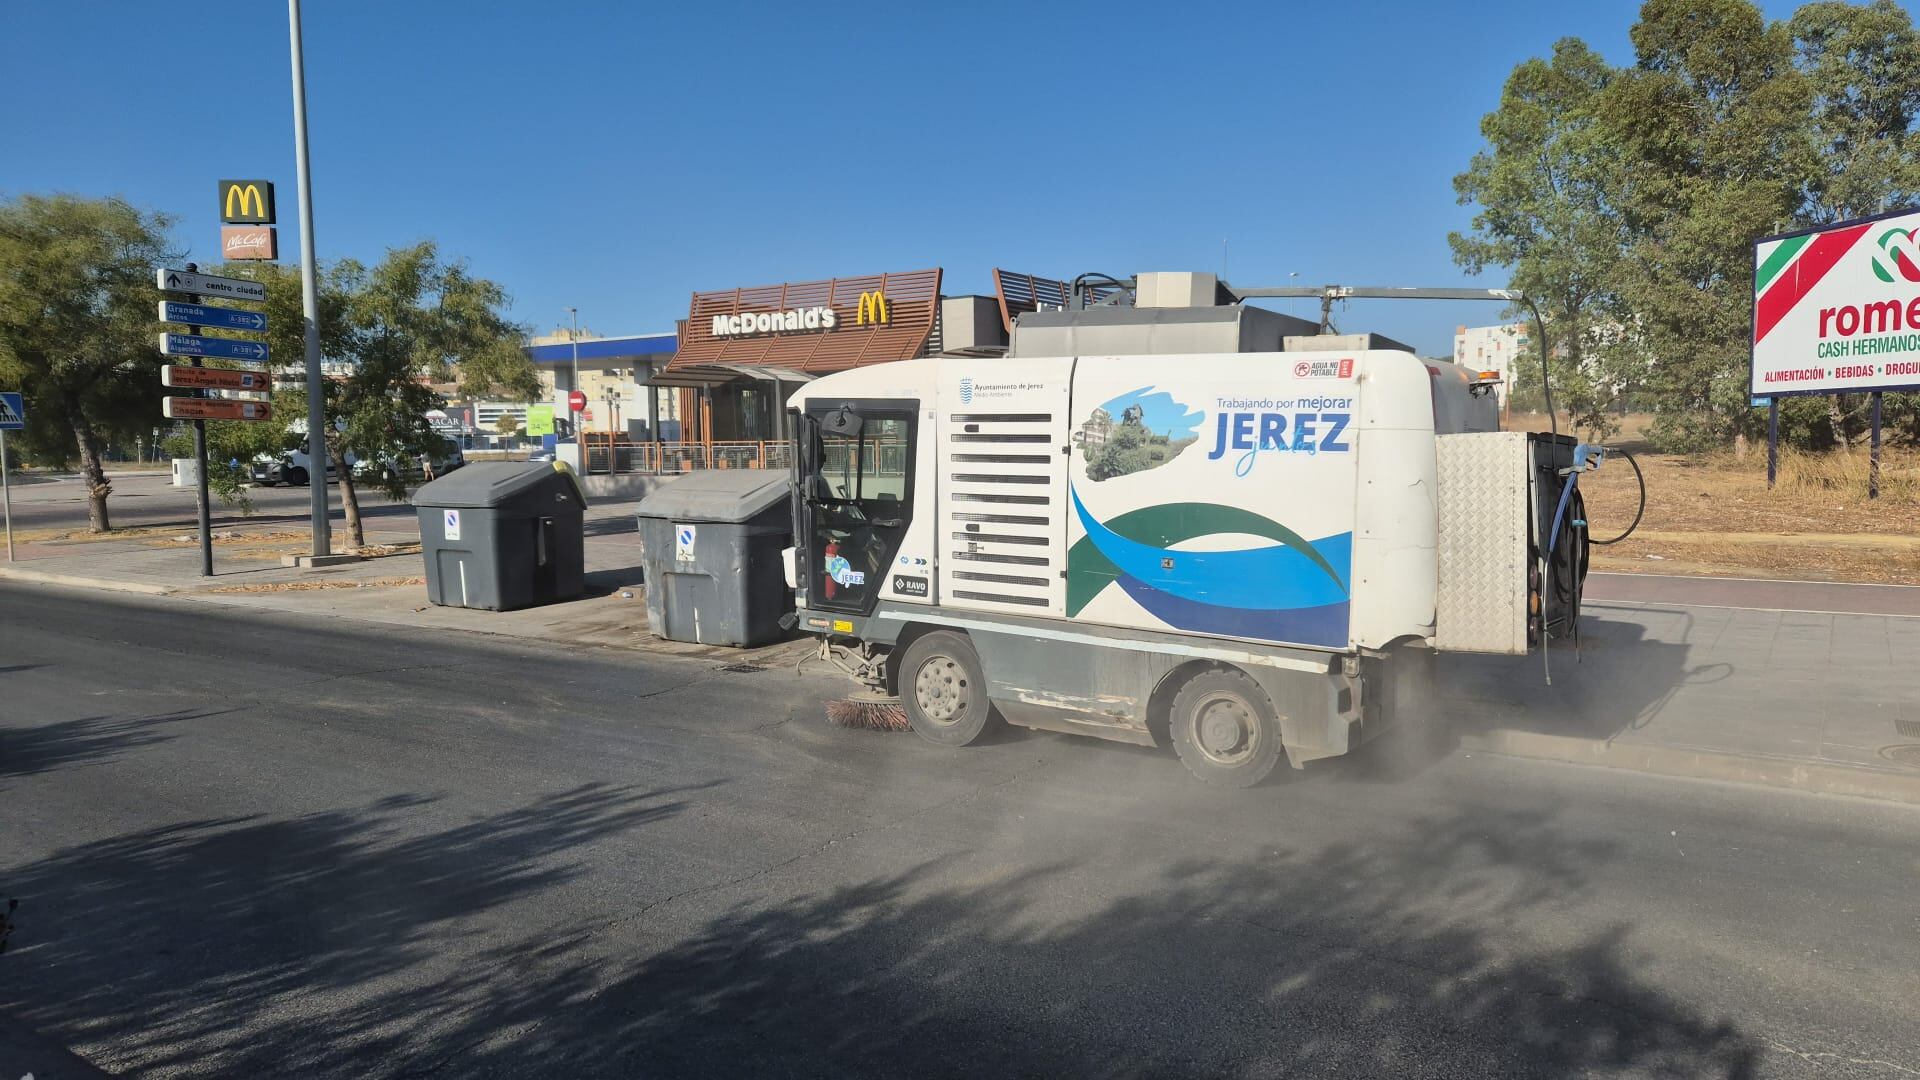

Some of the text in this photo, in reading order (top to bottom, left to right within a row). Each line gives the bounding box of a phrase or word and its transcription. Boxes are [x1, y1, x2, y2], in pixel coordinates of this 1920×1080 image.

[206, 282, 263, 296] centro ciudad
[168, 304, 204, 315] Granada
[712, 306, 835, 336] McDonald's
[1818, 342, 1849, 358] CASH
[1765, 366, 1825, 383] ALIMENTACIÓN
[1835, 365, 1874, 379] BEBIDAS
[1217, 396, 1352, 412] Trabajando por mejorar
[1208, 413, 1350, 460] JEREZ
[842, 573, 864, 585] JEREZ
[906, 581, 926, 590] RAVO
